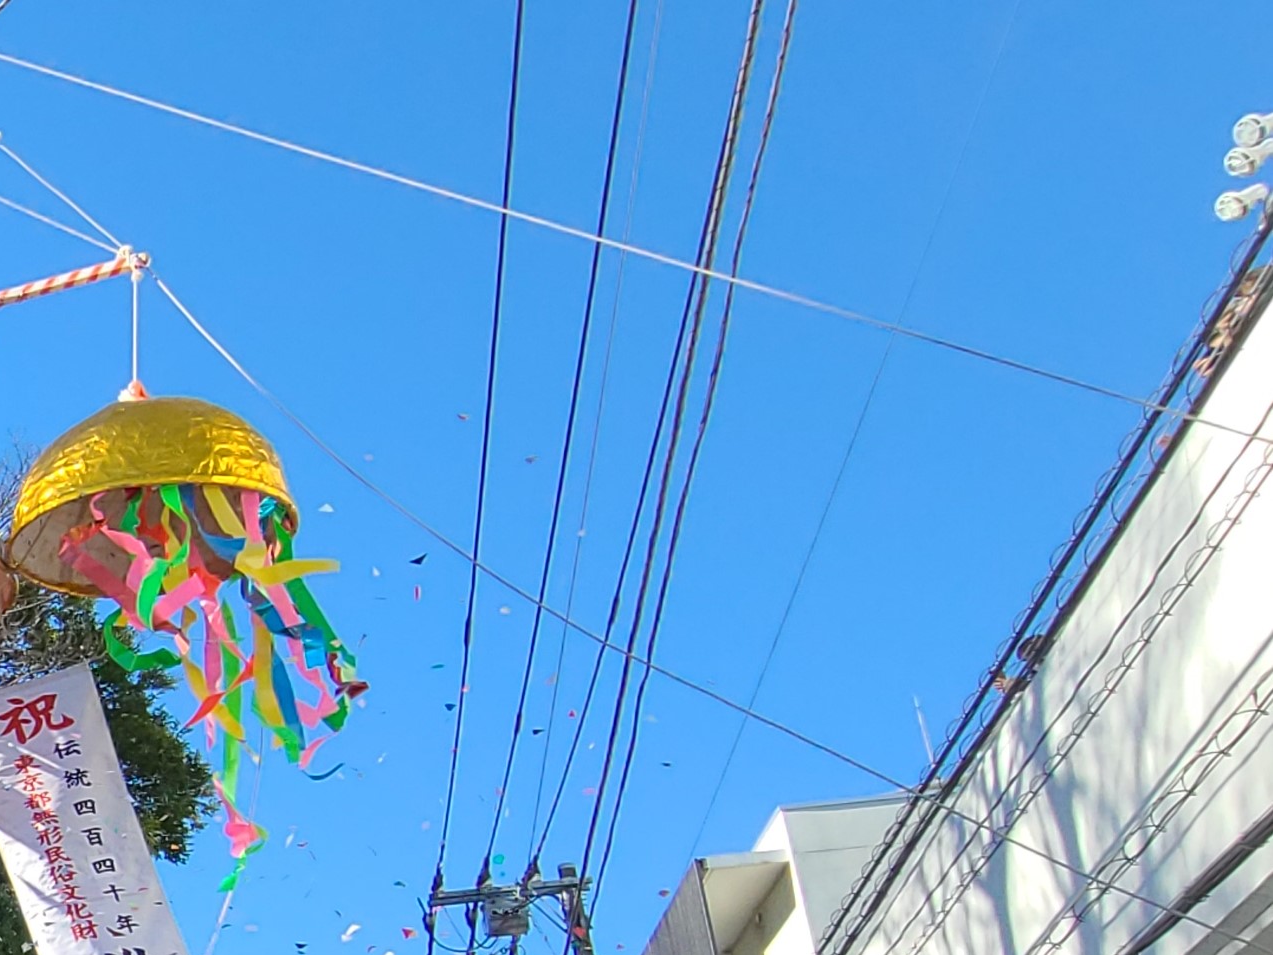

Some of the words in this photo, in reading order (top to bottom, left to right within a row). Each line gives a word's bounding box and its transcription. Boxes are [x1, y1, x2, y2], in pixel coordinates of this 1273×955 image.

[13, 754, 99, 941] 東京都無形民俗文化財
[53, 740, 140, 935] 伝統四百四十年
